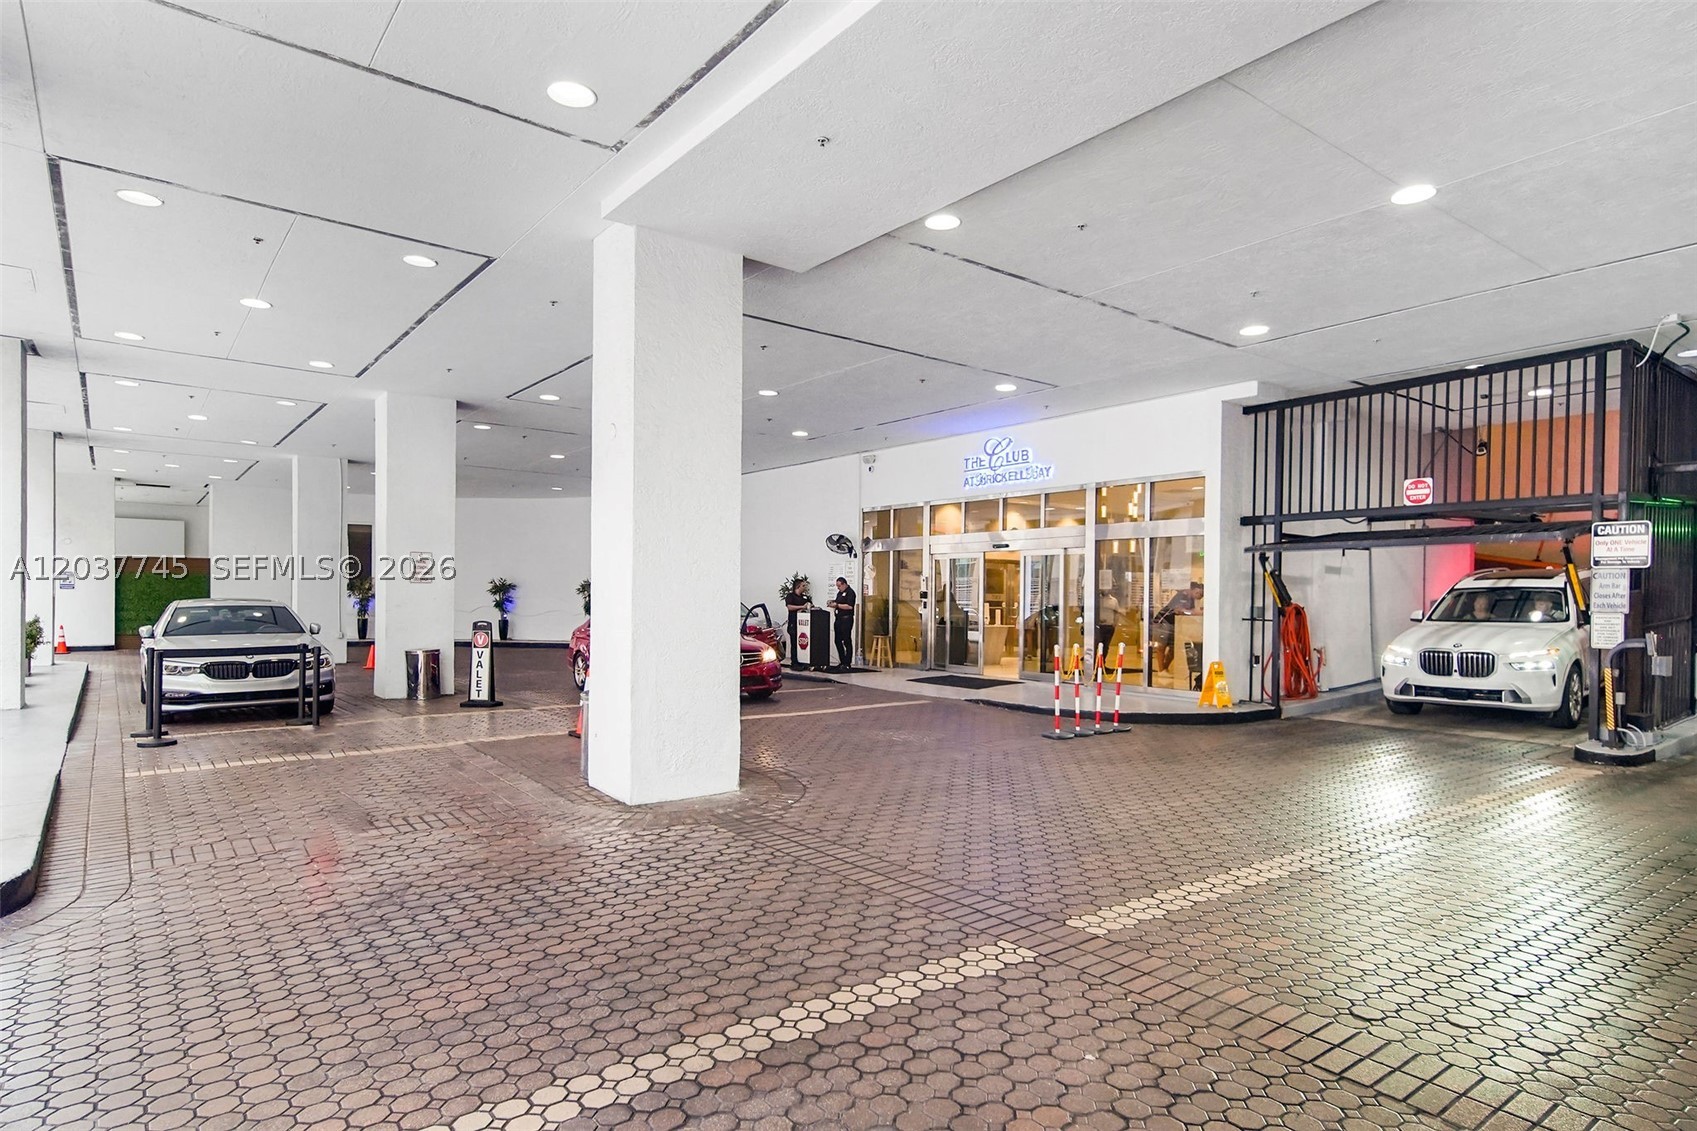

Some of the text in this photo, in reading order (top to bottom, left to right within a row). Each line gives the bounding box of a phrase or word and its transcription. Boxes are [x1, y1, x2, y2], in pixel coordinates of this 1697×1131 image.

[964, 456, 986, 469] THE
[963, 476, 975, 487] AT
[1597, 524, 1646, 535] CAUTION
[1592, 572, 1626, 580] CAUTION
[476, 634, 485, 645] V
[476, 650, 484, 698] VALET
